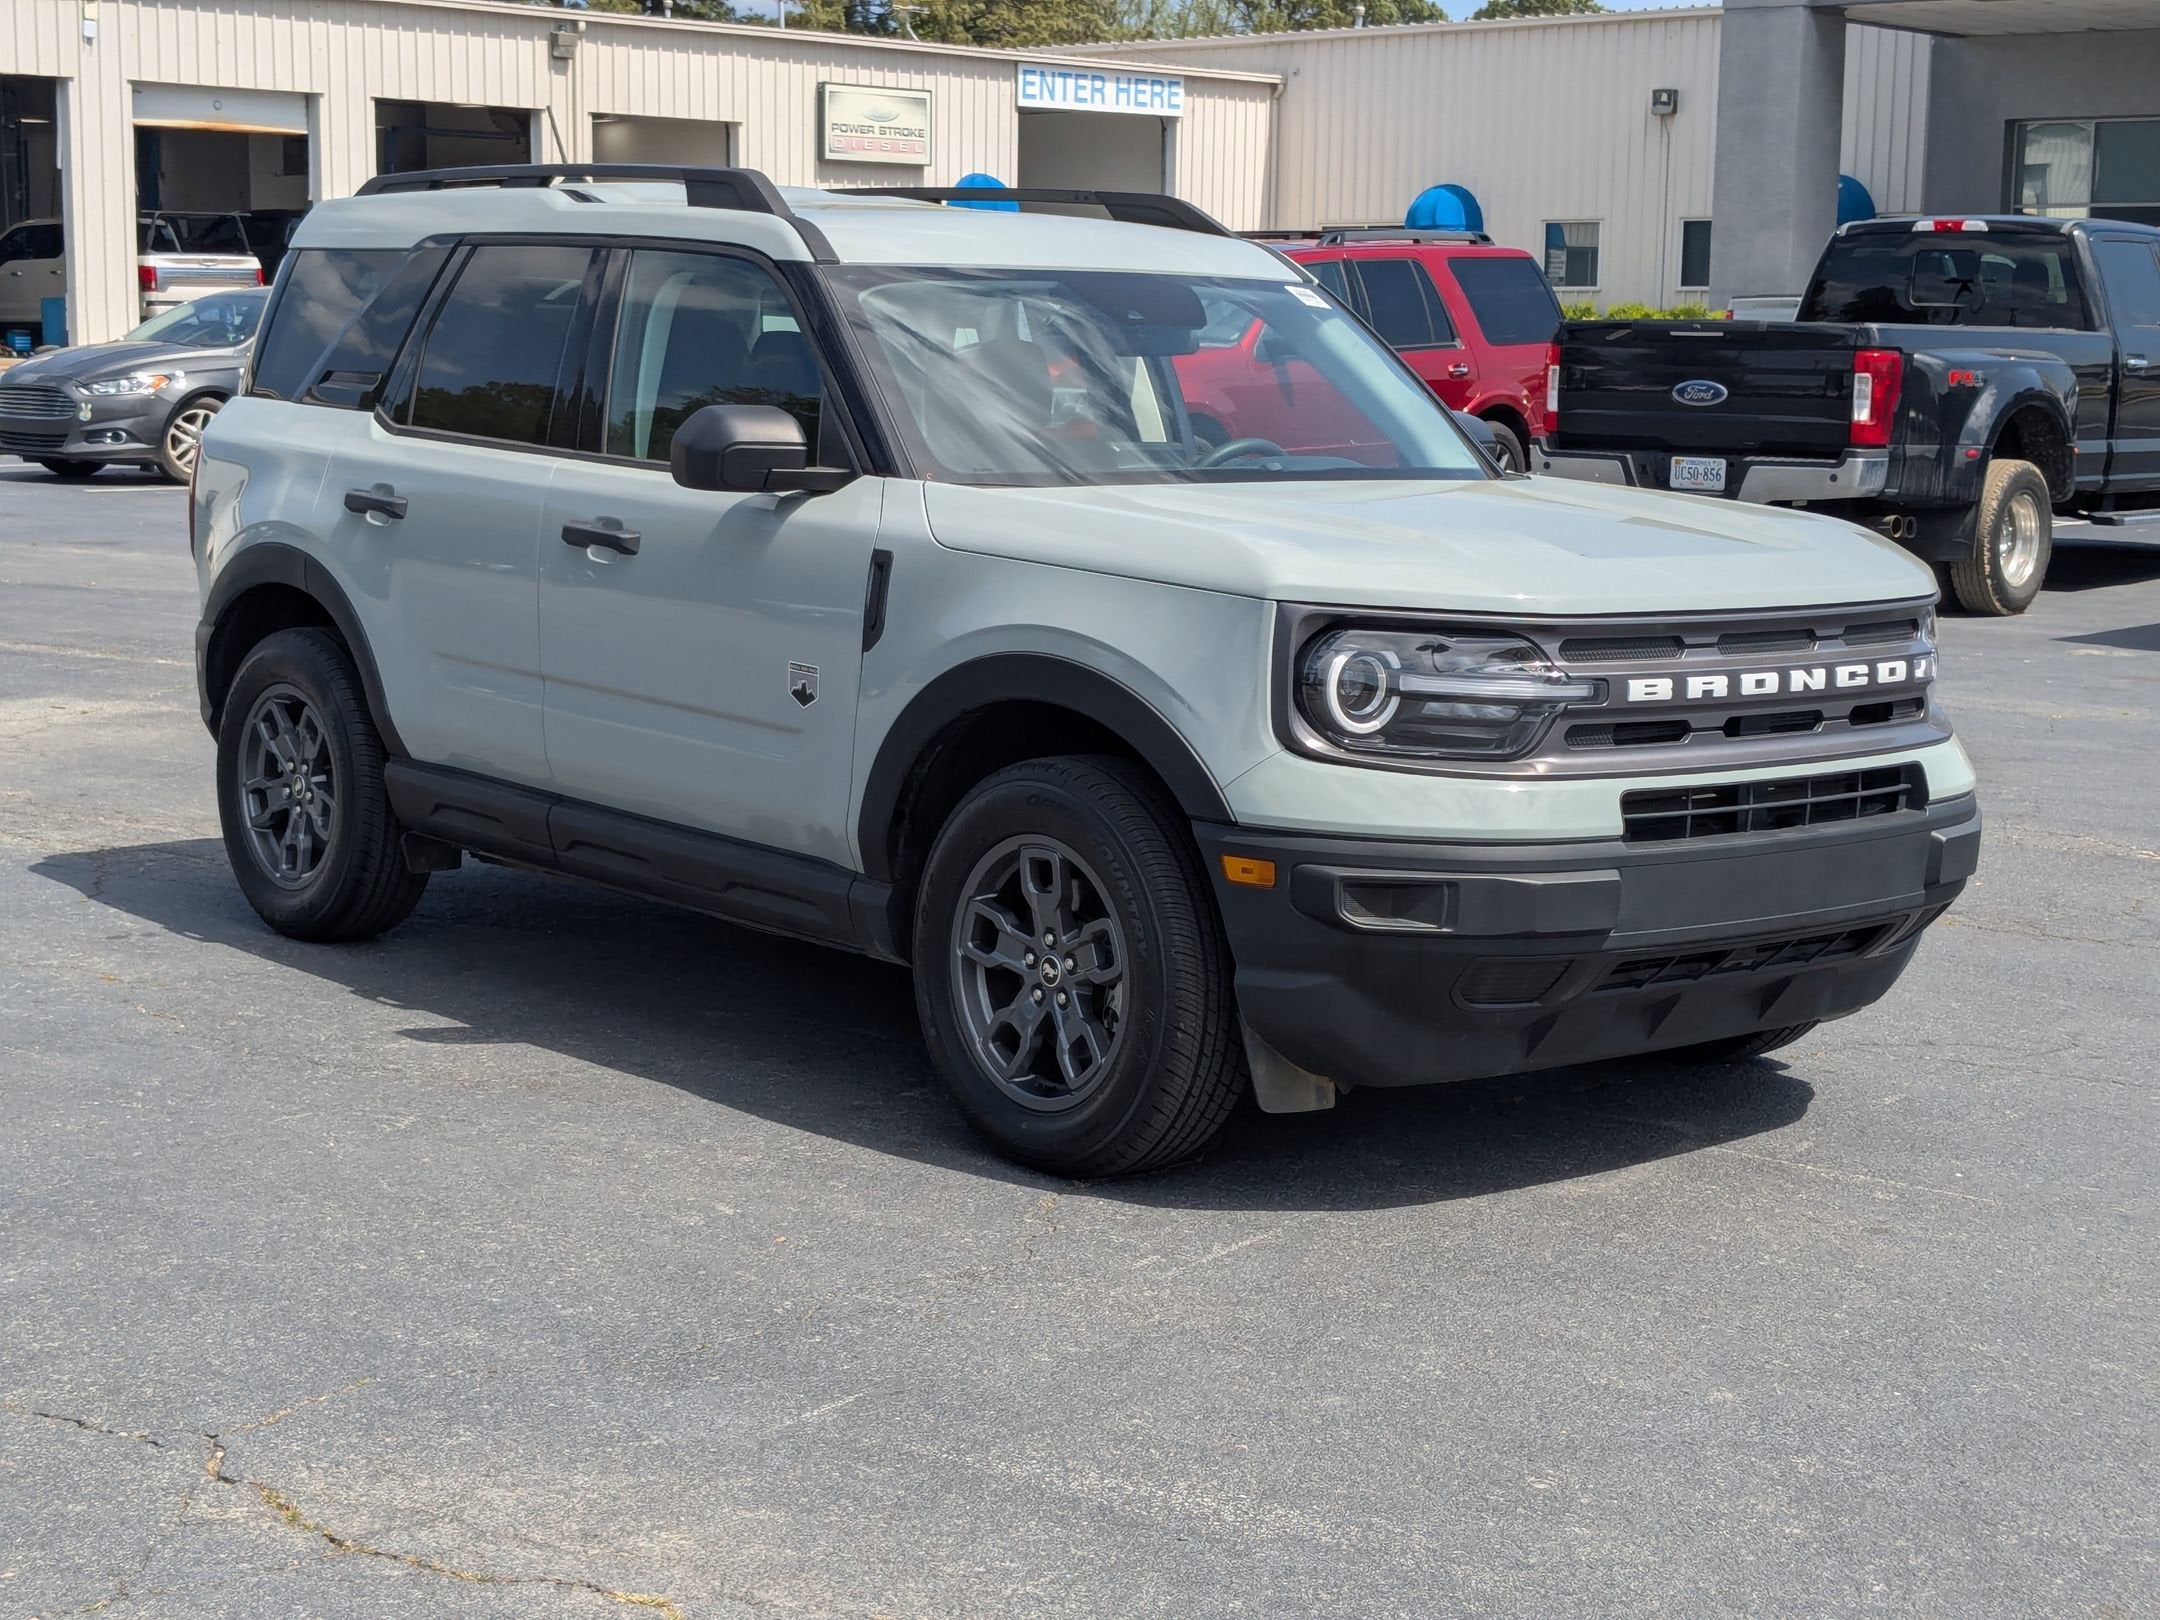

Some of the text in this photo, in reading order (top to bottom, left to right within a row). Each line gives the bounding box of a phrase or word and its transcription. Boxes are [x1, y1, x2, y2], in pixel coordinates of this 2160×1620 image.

[1022, 69, 1181, 110] ENTER HERE
[831, 122, 925, 138] POWER STROKE
[833, 138, 924, 153] DIESEL
[1684, 385, 1714, 399] Ford
[1674, 465, 1722, 482] UC50-856
[1627, 660, 1907, 702] BRONCO
